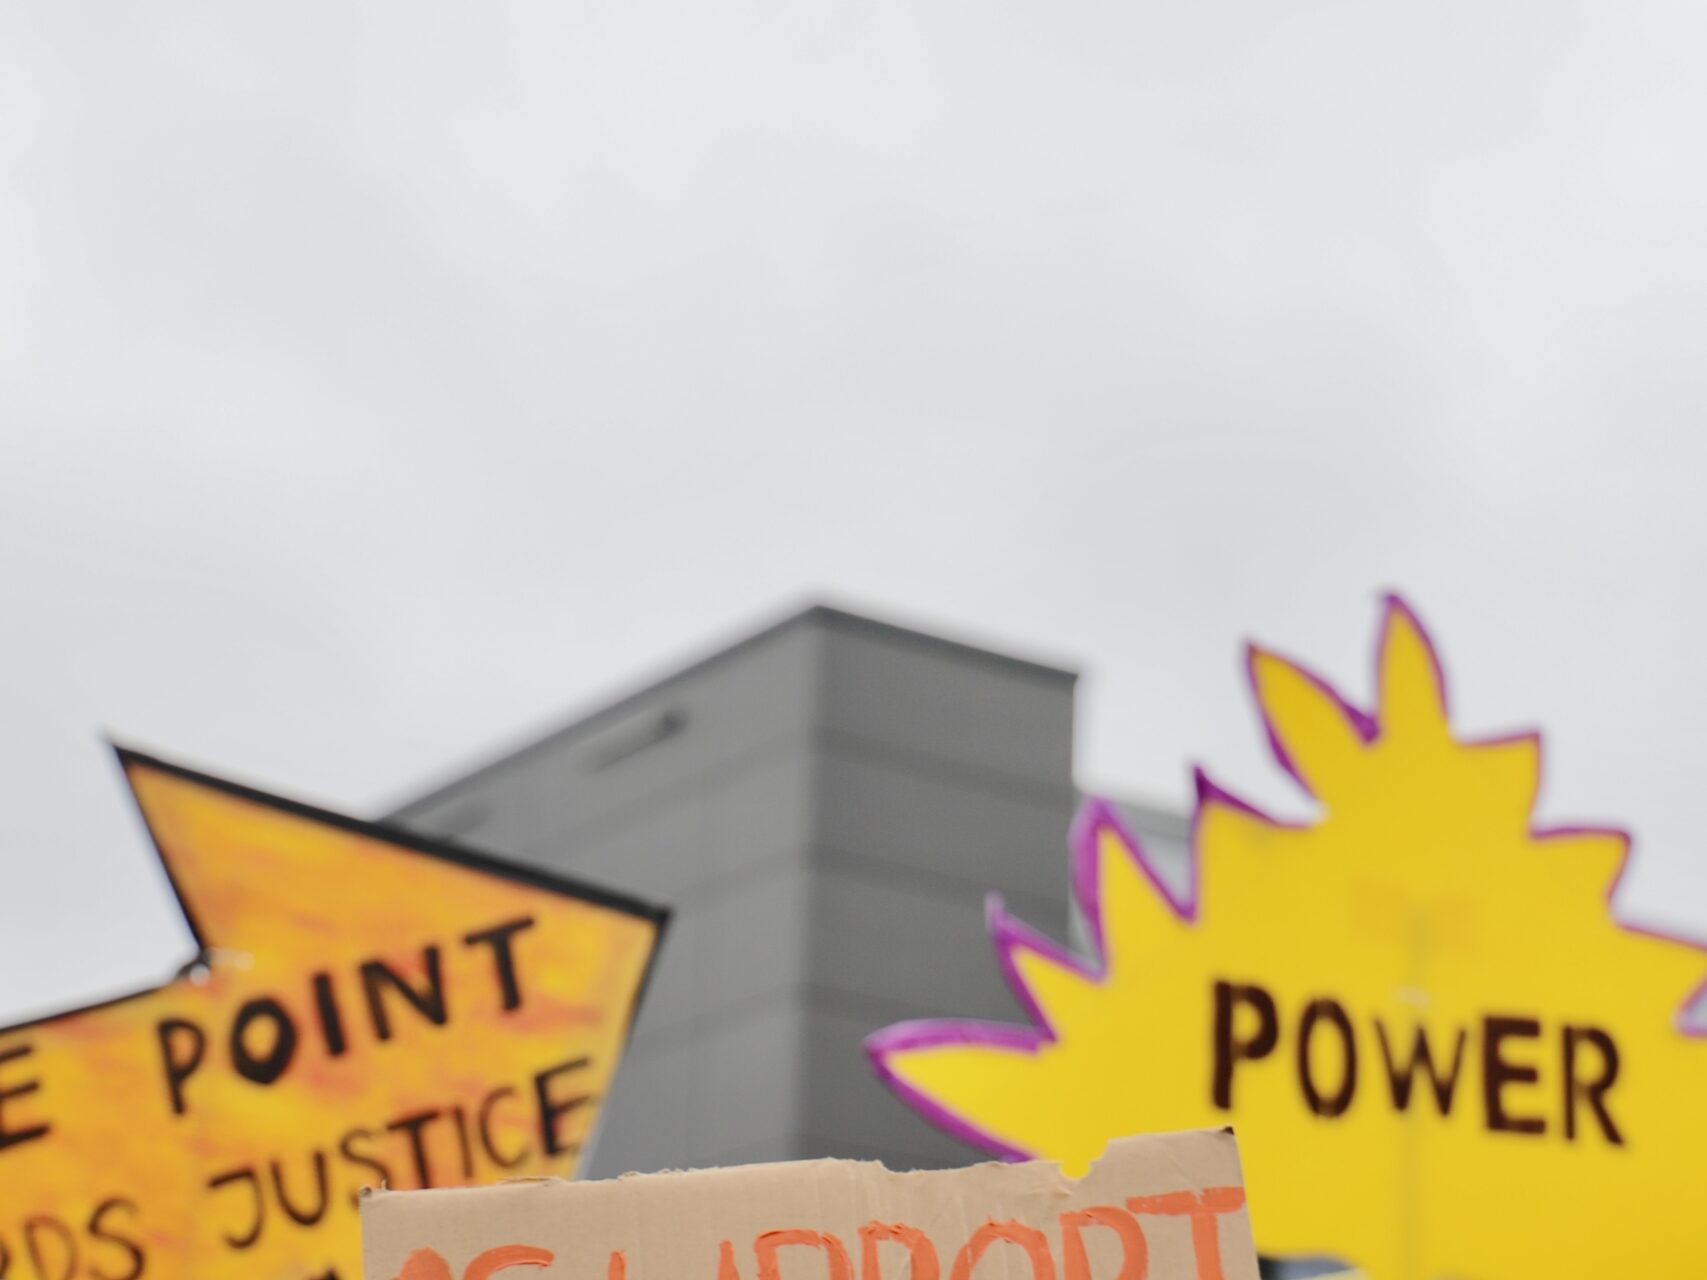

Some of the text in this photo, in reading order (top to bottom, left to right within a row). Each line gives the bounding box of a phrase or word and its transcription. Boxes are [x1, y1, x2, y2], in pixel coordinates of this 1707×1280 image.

[157, 914, 535, 1118] POINT
[1211, 979, 1627, 1148] POWER
[207, 1056, 595, 1250] JUSTICE
